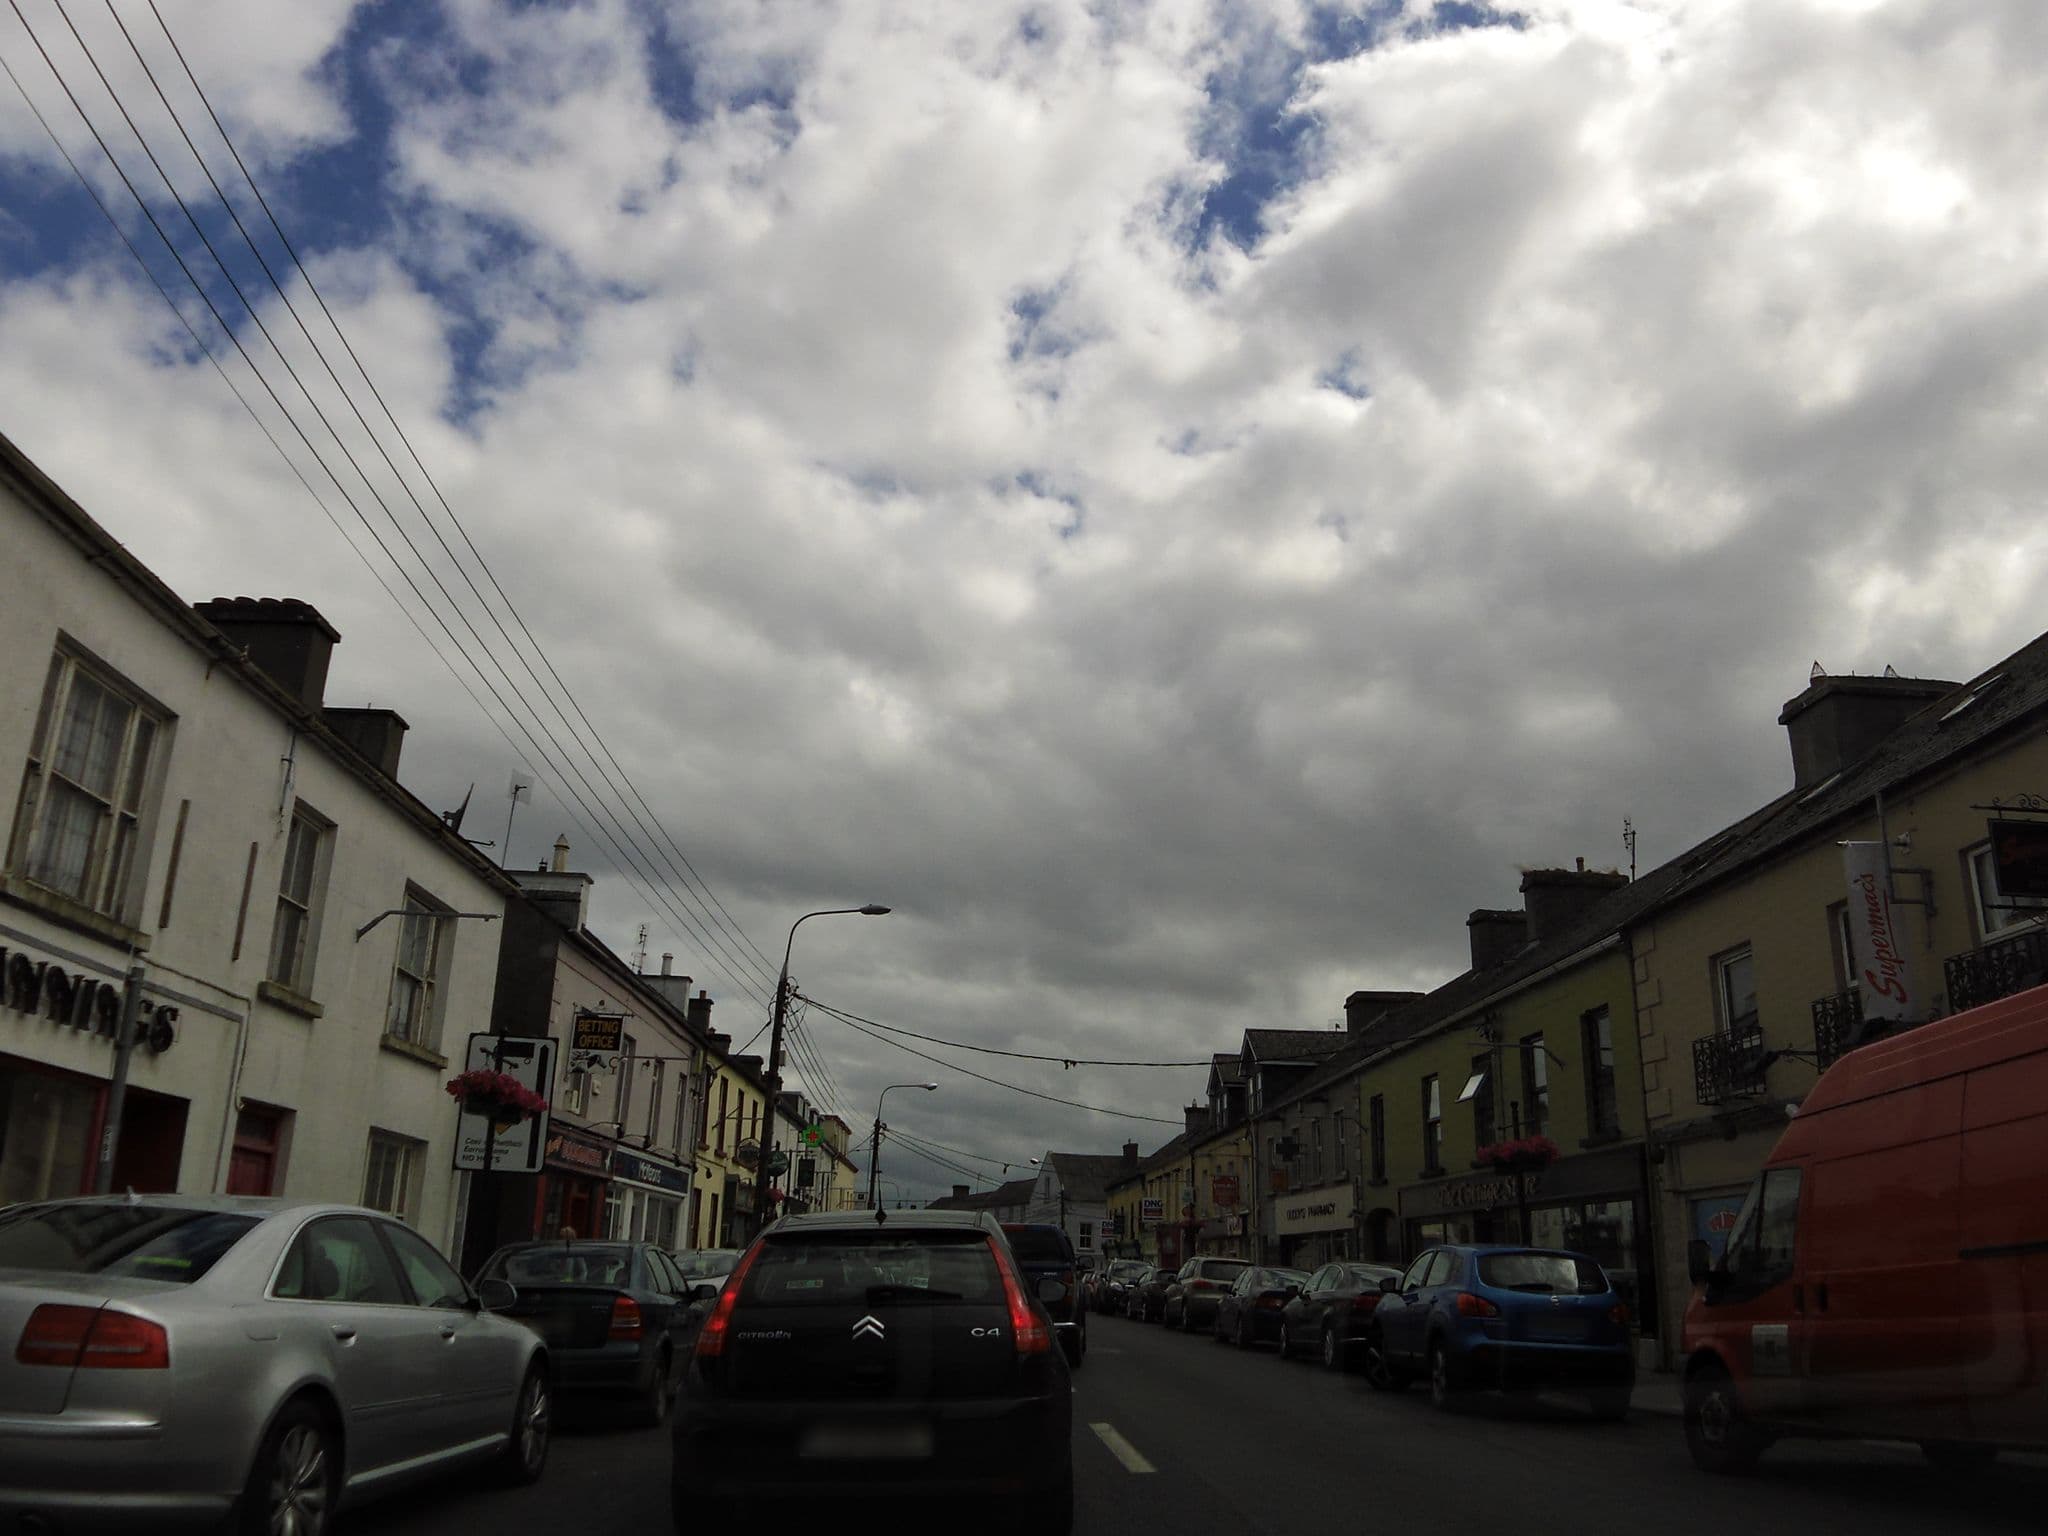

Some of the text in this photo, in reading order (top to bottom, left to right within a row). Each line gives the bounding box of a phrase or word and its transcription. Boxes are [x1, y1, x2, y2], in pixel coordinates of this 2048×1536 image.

[0, 947, 178, 1052] NNINGS
[578, 1019, 618, 1034] BETTING
[579, 1034, 615, 1048] OFFICE
[1504, 1175, 1537, 1201] Stre
[1143, 1199, 1163, 1207] DNG
[970, 1326, 1001, 1338] C4
